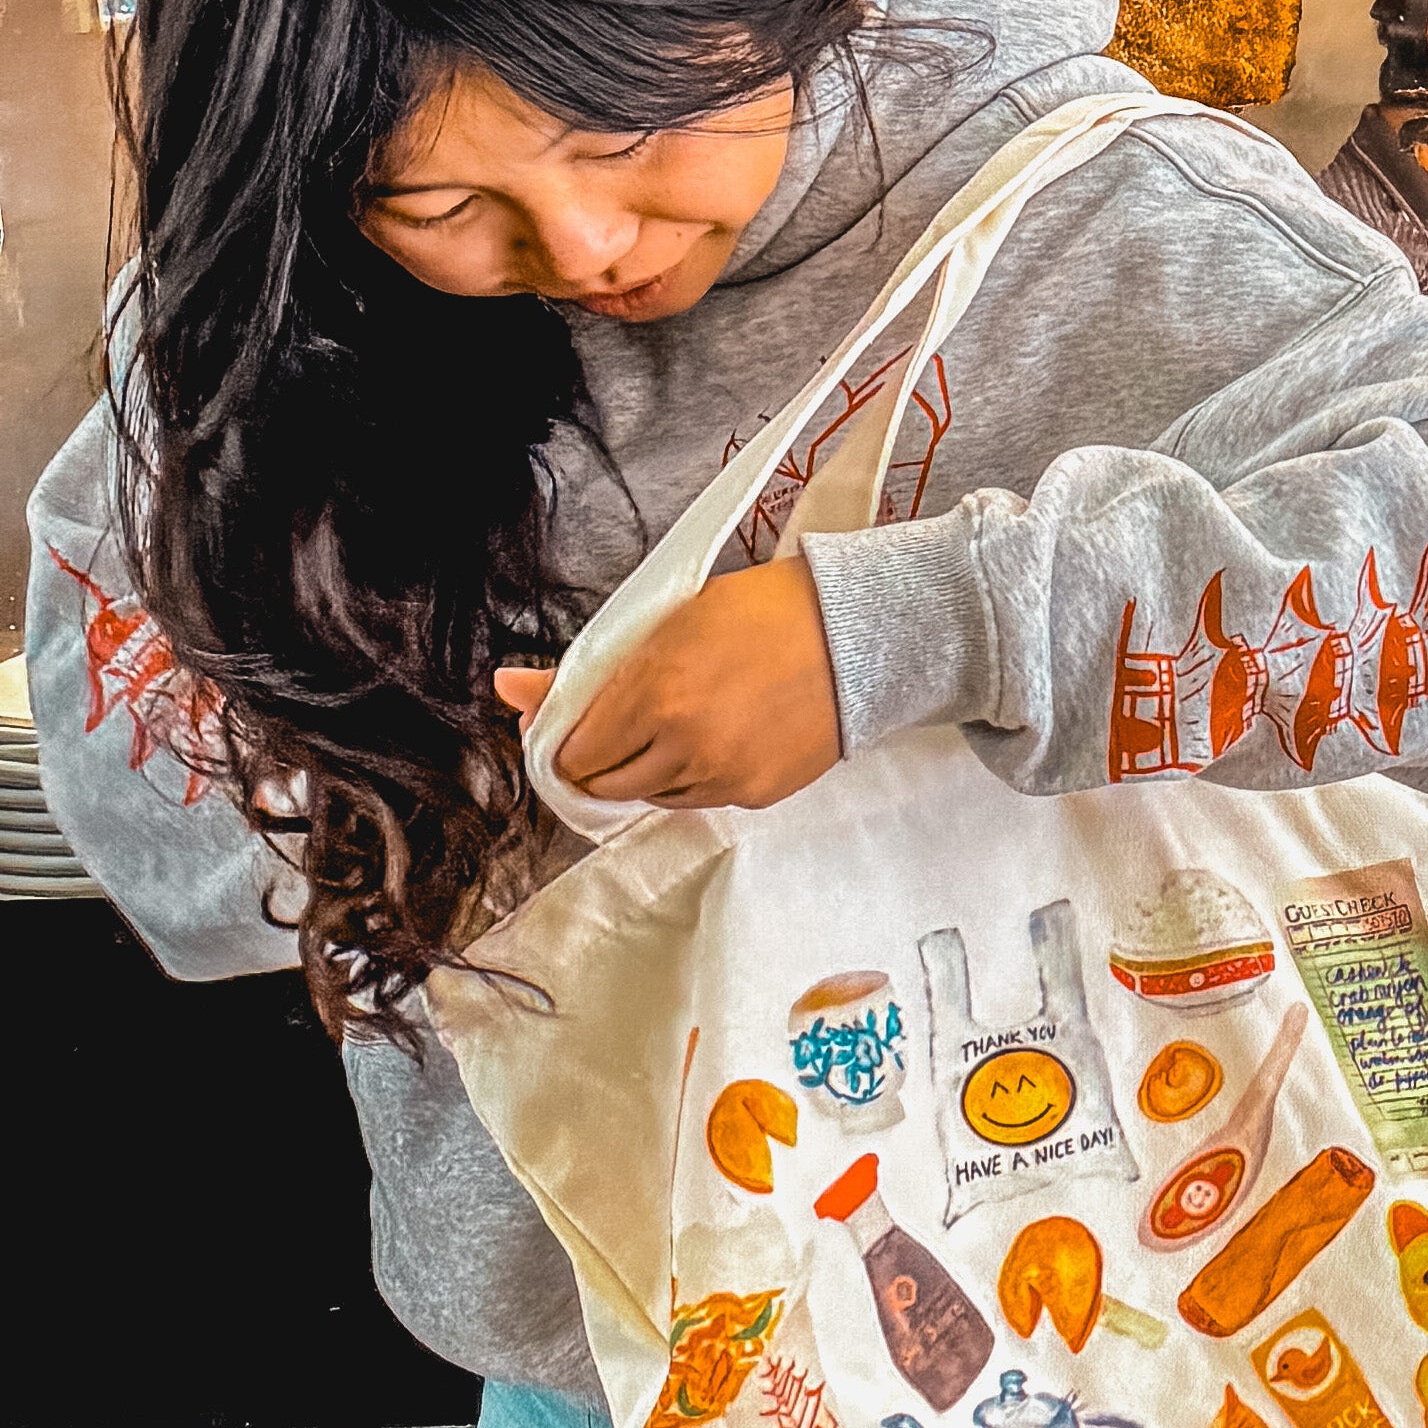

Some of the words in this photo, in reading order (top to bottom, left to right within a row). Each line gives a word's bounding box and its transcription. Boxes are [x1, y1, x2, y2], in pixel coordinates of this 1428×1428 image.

[1334, 892, 1397, 916] CHECK
[962, 1030, 1023, 1063] THANK
[1027, 1025, 1056, 1041] YOU
[956, 1154, 1002, 1186] HAVE
[1012, 1152, 1029, 1171] A
[1034, 1138, 1075, 1165] NICE
[1080, 1127, 1113, 1151] DAY!
